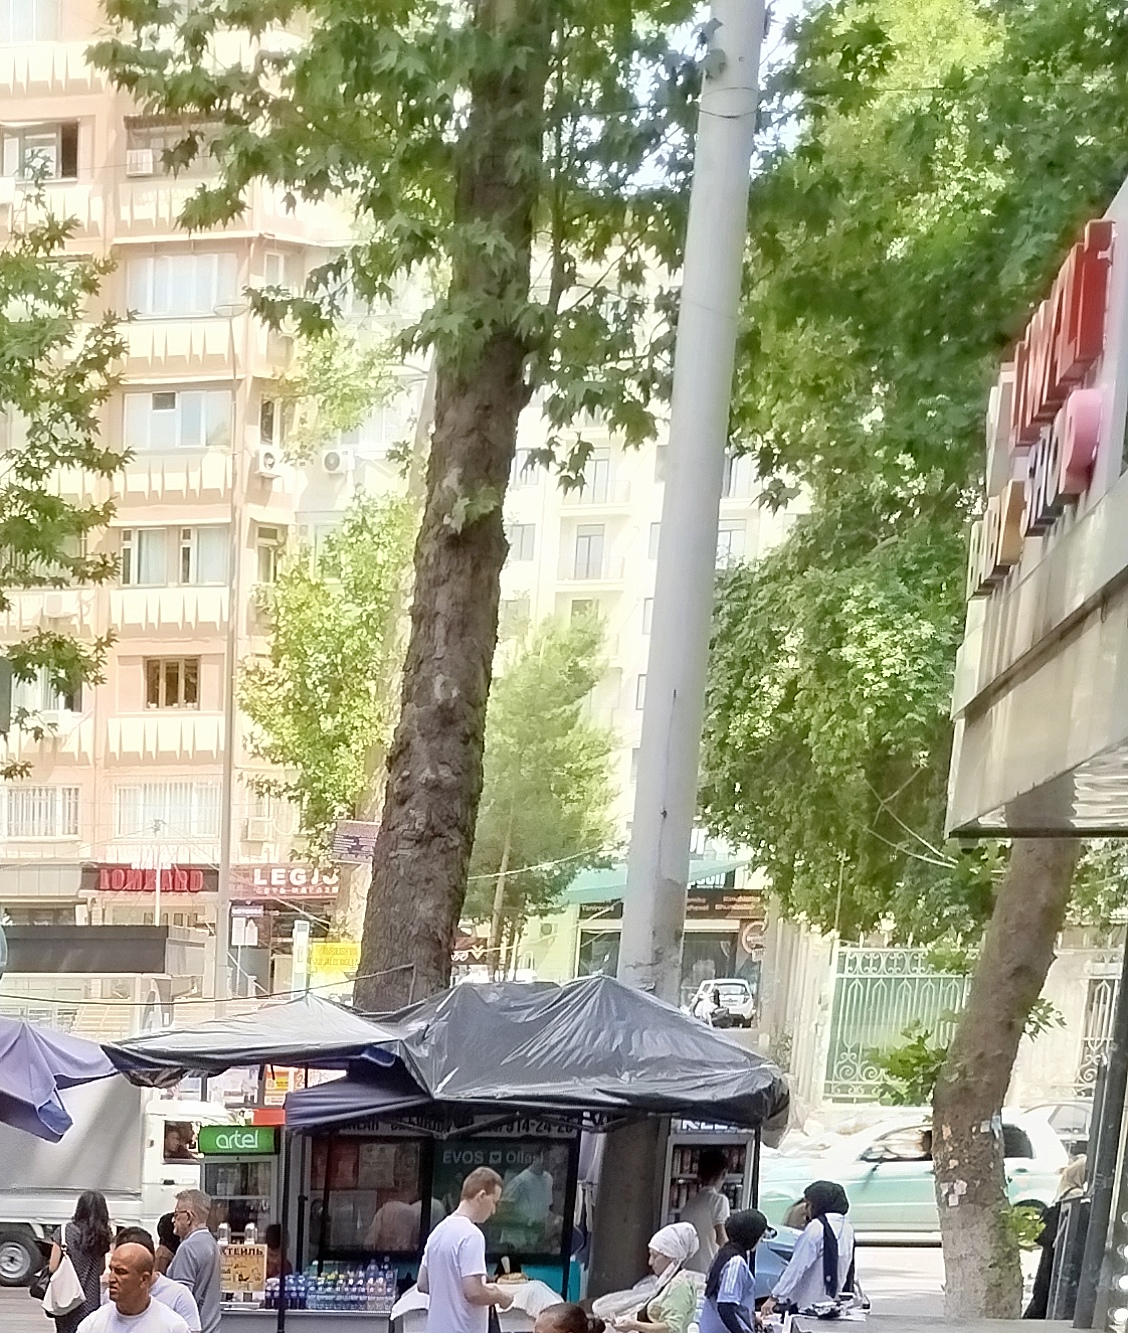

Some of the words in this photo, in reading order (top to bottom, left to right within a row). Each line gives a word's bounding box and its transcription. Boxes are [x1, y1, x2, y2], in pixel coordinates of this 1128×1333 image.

[99, 868, 204, 891] LOMBARD
[215, 1129, 259, 1149] artel
[442, 1150, 484, 1164] EVOS
